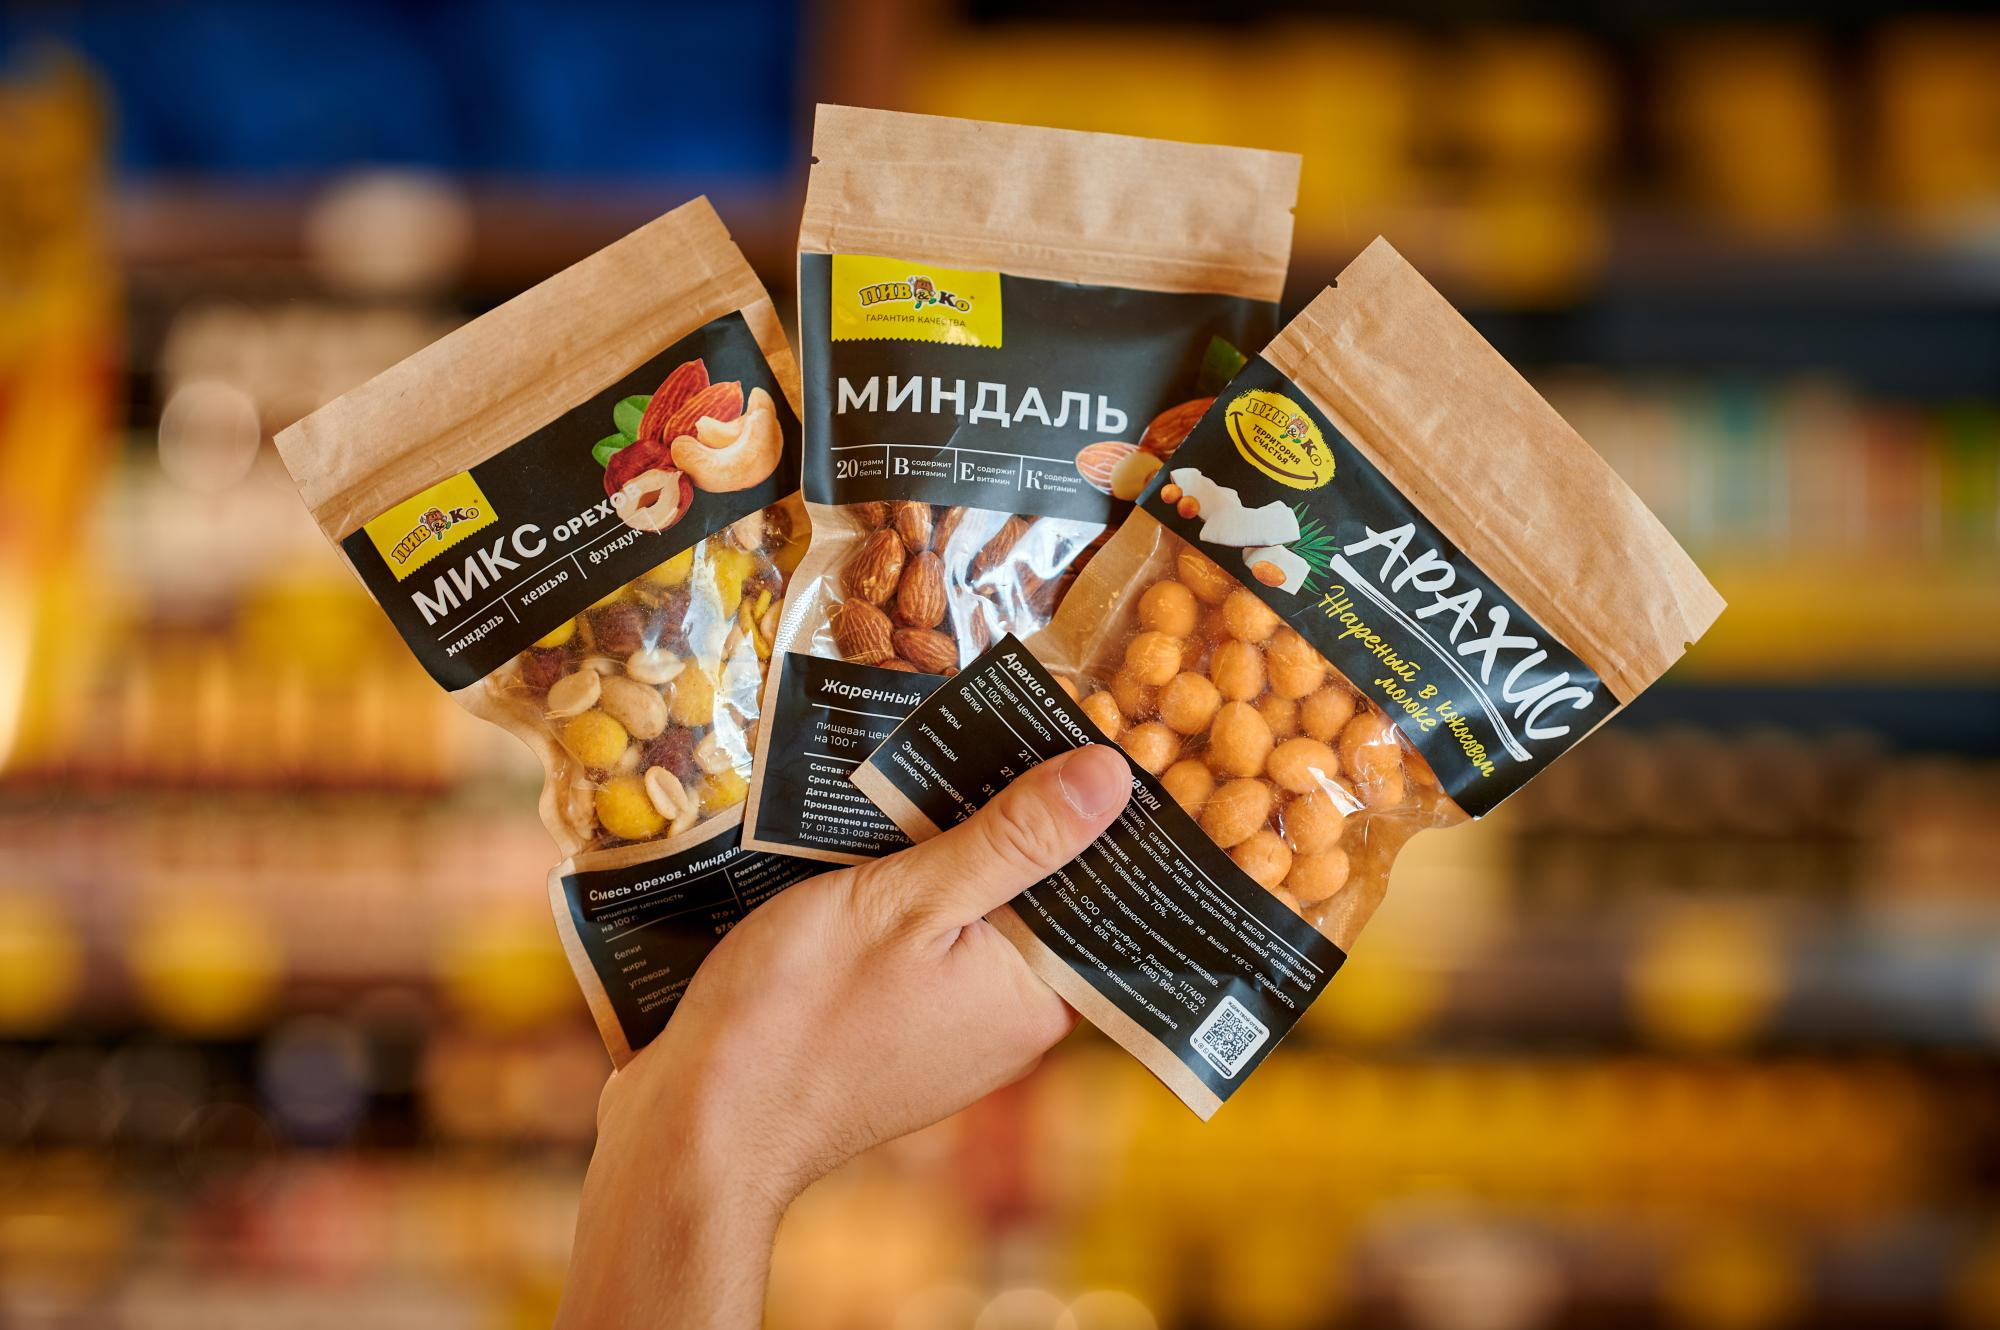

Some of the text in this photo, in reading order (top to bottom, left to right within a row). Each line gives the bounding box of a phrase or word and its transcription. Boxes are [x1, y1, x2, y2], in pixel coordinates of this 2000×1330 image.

[917, 316, 965, 326] КАЧЕСТВА
[838, 376, 1127, 433] МИНДАЛЬ
[1251, 423, 1301, 465] ТЕРРИТОРИЯ
[1252, 434, 1289, 465] СЧАСТЬЯ
[836, 458, 858, 478] 20
[894, 457, 909, 474] В
[960, 461, 974, 481] Е
[976, 466, 1016, 478] содержит
[1025, 469, 1042, 489] К
[1043, 474, 1082, 483] содержит
[976, 476, 1010, 486] витамин
[1043, 484, 1076, 493] витамин
[411, 484, 640, 624] МИКС ОРЕХОВ
[445, 528, 642, 656] миндаль кешью фундук
[1344, 523, 1594, 740] АРАХИС
[820, 678, 920, 707] Жаренный
[974, 675, 1004, 708] на 100г:
[1002, 652, 1045, 696] Арахис
[1044, 697, 1055, 707] в
[1319, 585, 1494, 778] Жареный в кокосовом
[959, 686, 982, 713] белки
[984, 666, 1050, 741] Пищевая ценность
[1376, 676, 1437, 732] молоке
[816, 721, 865, 736] пищевая
[938, 704, 961, 729] жиры
[814, 734, 827, 742] на
[830, 735, 849, 746] 100
[918, 723, 958, 761] углеводы
[808, 774, 830, 784] Срок
[810, 762, 843, 774] Состав:
[891, 751, 931, 789] ценность:
[901, 740, 963, 802] Энергетическая
[803, 799, 877, 816] Производитель:
[805, 787, 873, 804] Дата изготовл
[800, 821, 913, 846] ТУ 01.25.31-008-2062743
[802, 811, 860, 826] Изготовлено
[798, 832, 880, 852] Миндаль жареный
[733, 859, 764, 878] Состав:
[589, 886, 630, 900] Смесь
[634, 870, 685, 890] орехов.
[1100, 830, 1132, 865] ранения:
[1131, 864, 1146, 880] при
[1147, 880, 1194, 925] температуре
[1194, 925, 1206, 935] не
[1206, 935, 1228, 953] выше
[1112, 860, 1152, 902] превышать
[1150, 899, 1167, 918] 70%.
[1125, 802, 1315, 982] Арахис, сахар, мука пшеничная, масло растительное,
[600, 923, 613, 934] на
[613, 916, 630, 928] 100
[1139, 839, 1173, 874] цикломат
[1171, 873, 1198, 901] натрия,
[1199, 899, 1235, 932] краситель
[1235, 930, 1269, 958] пищевой
[1269, 956, 1312, 992] «солнечный
[1046, 877, 1198, 1014] ул. Дорожная, 60Б. Тел.: +7 (495) 966-01-32.
[1080, 895, 1099, 915] ООО
[1102, 918, 1140, 954] «БестФуд»,
[1145, 953, 1173, 980] Россия,
[1179, 980, 1206, 1006] 117405,
[1100, 883, 1117, 901] срок
[1116, 900, 1148, 930] годности
[1145, 928, 1177, 953] указаны
[1175, 951, 1186, 960] на
[1184, 958, 1218, 987] упаковке.
[613, 943, 642, 960] белки
[622, 961, 647, 973] жиры
[1037, 906, 1047, 917] на
[1045, 915, 1075, 944] этикетке
[1074, 943, 1107, 971] является
[1106, 969, 1147, 1005] элементом
[1145, 1003, 1177, 1029] дизайна
[628, 968, 670, 988] углеводы
